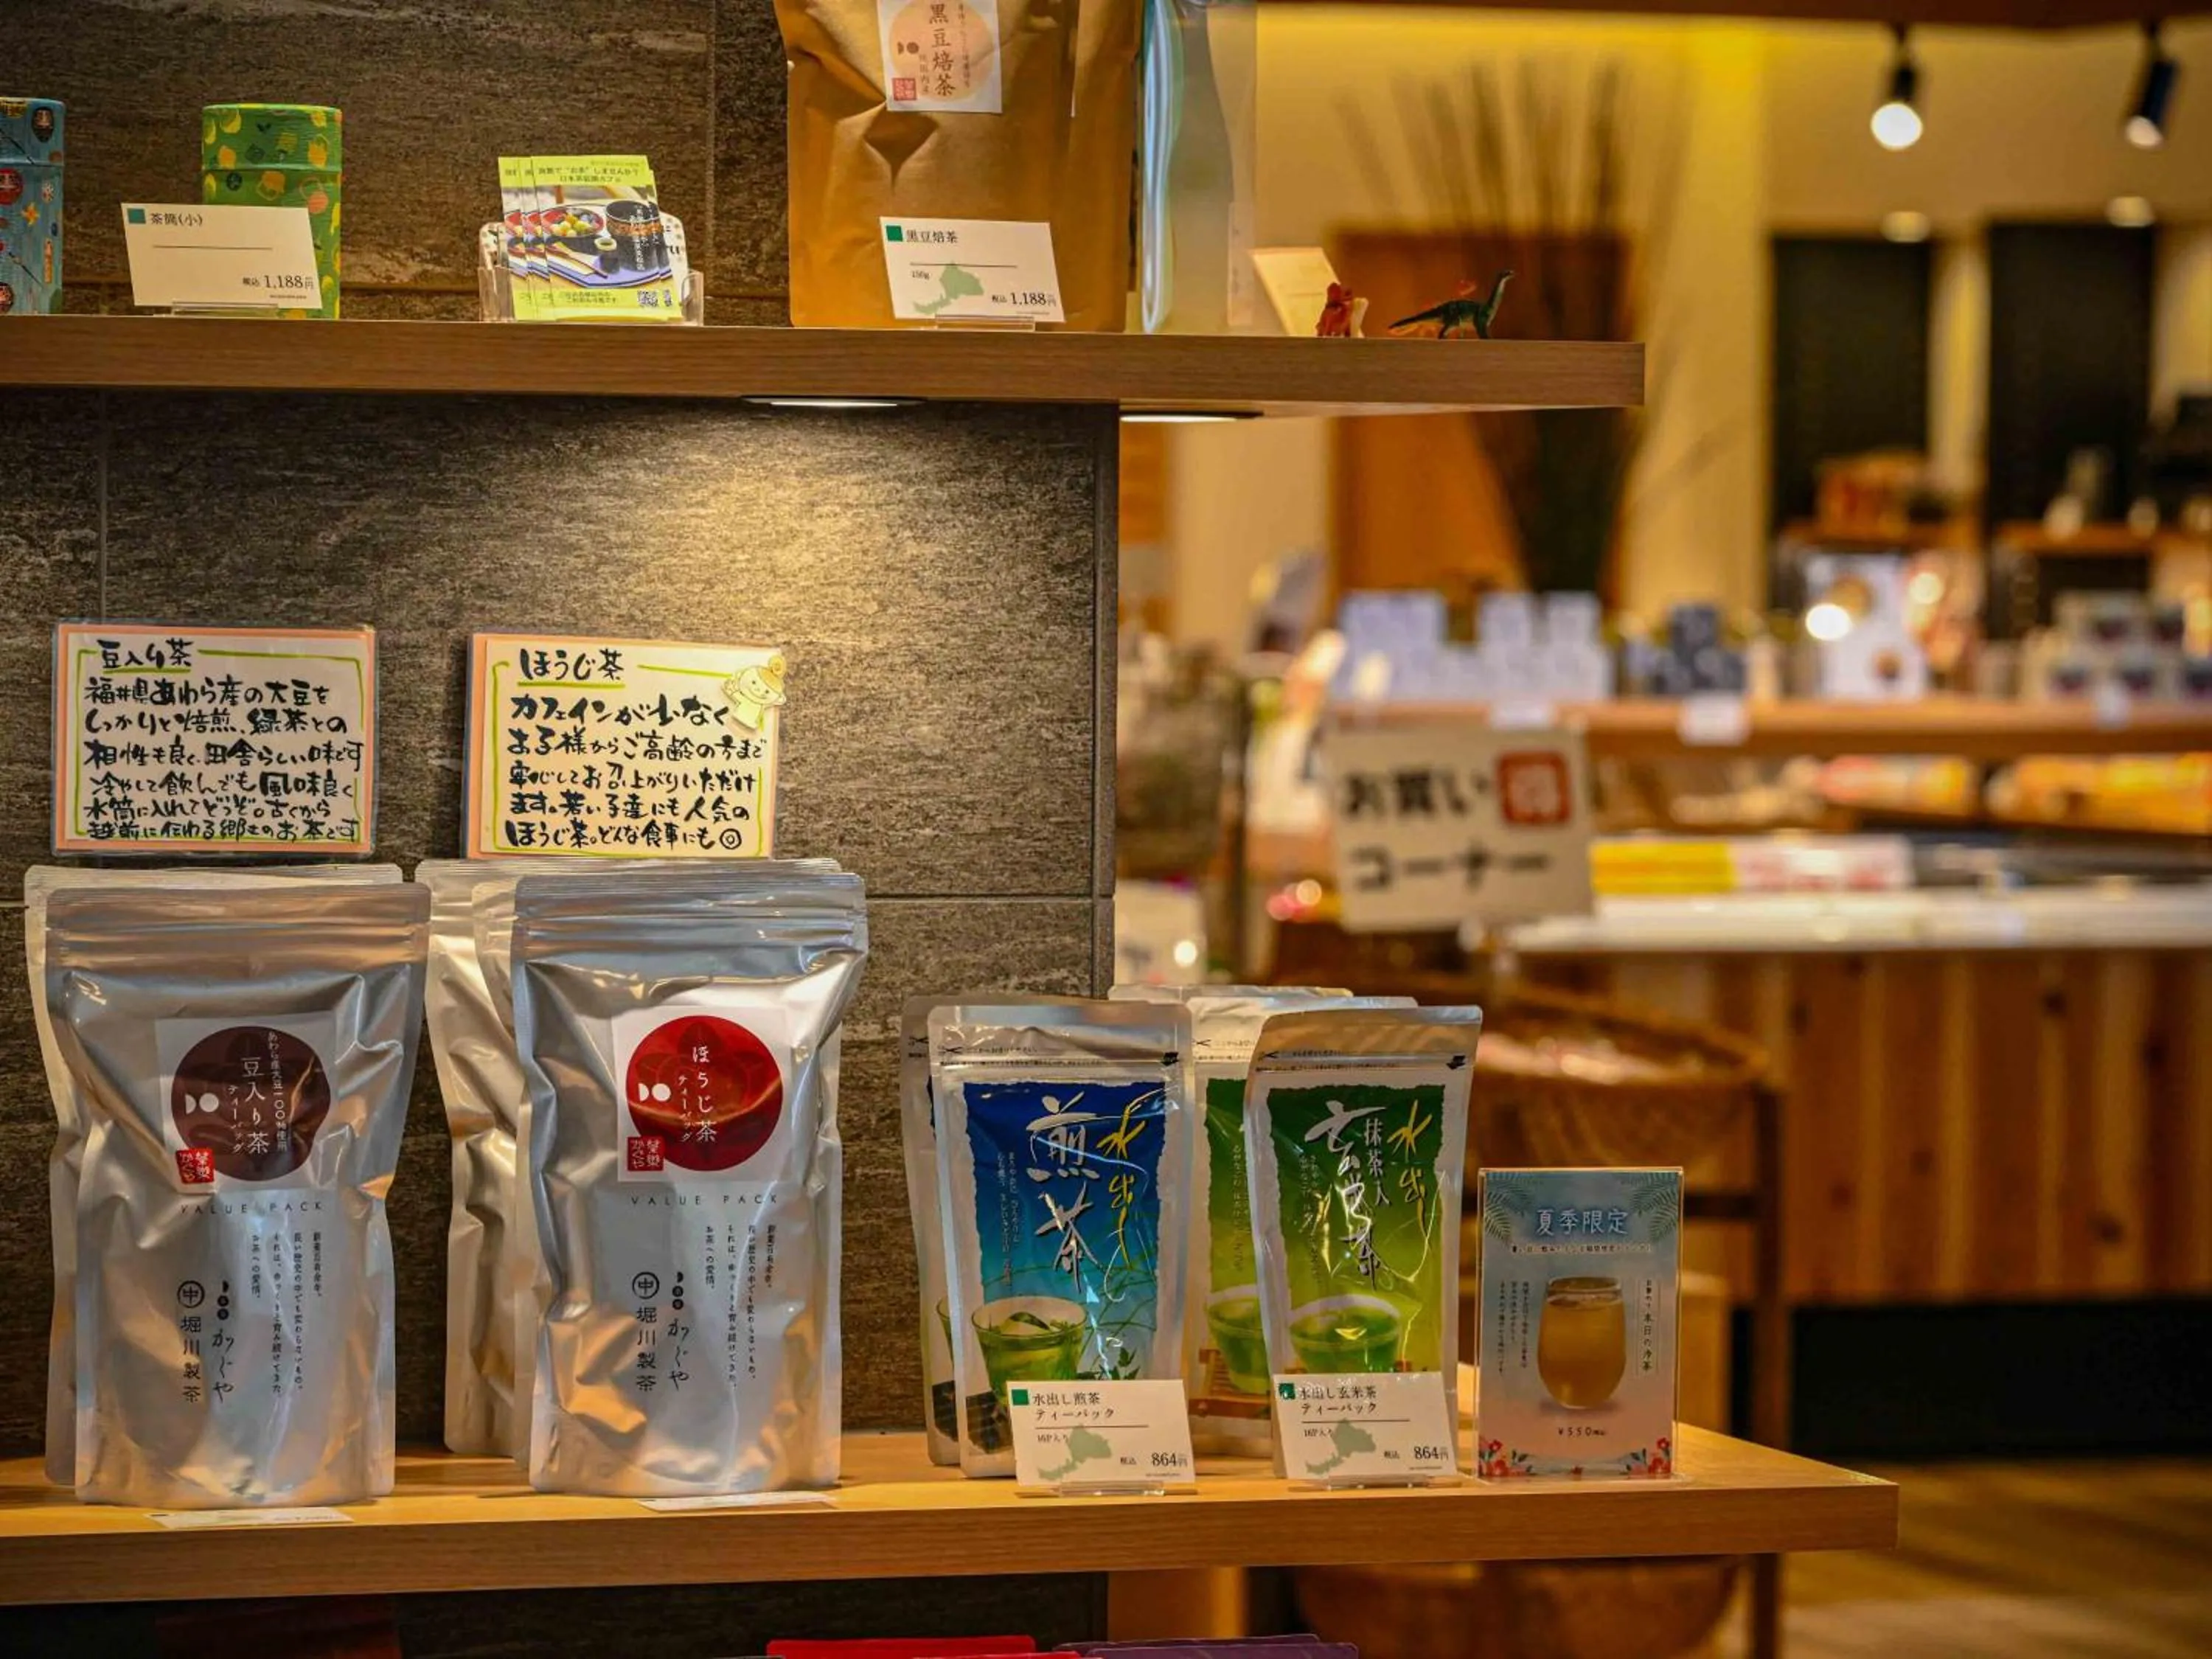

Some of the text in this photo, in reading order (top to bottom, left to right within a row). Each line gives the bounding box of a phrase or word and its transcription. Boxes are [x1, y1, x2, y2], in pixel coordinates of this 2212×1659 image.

[929, 4, 956, 97] 黒豆焙茶
[906, 229, 959, 243] 黒豆焙茶
[97, 638, 194, 669] 豆入り茶
[519, 648, 625, 681] ほうじ茶
[84, 675, 330, 706] 福井県あわら産の大豆を
[511, 693, 730, 727] カフェインが少なく
[89, 769, 353, 798] 冷やして飲んでも風味良く
[510, 790, 750, 824] ます。若い子達にも人気の
[240, 1057, 269, 1154] 豆入り茶
[692, 1046, 717, 1142] ほうじ茶
[181, 1201, 322, 1214] VALUE PACK
[632, 1194, 777, 1205] VALUE PACK
[1537, 1208, 1629, 1237] 夏季限定
[181, 1315, 201, 1403] 堀川製茶
[636, 1307, 657, 1392] 堀川製茶
[1032, 1392, 1100, 1406] 水出し煎茶
[1298, 1385, 1376, 1400] 水出し玄米茶
[1151, 1453, 1187, 1467] 864円
[1413, 1446, 1449, 1460] 864円
